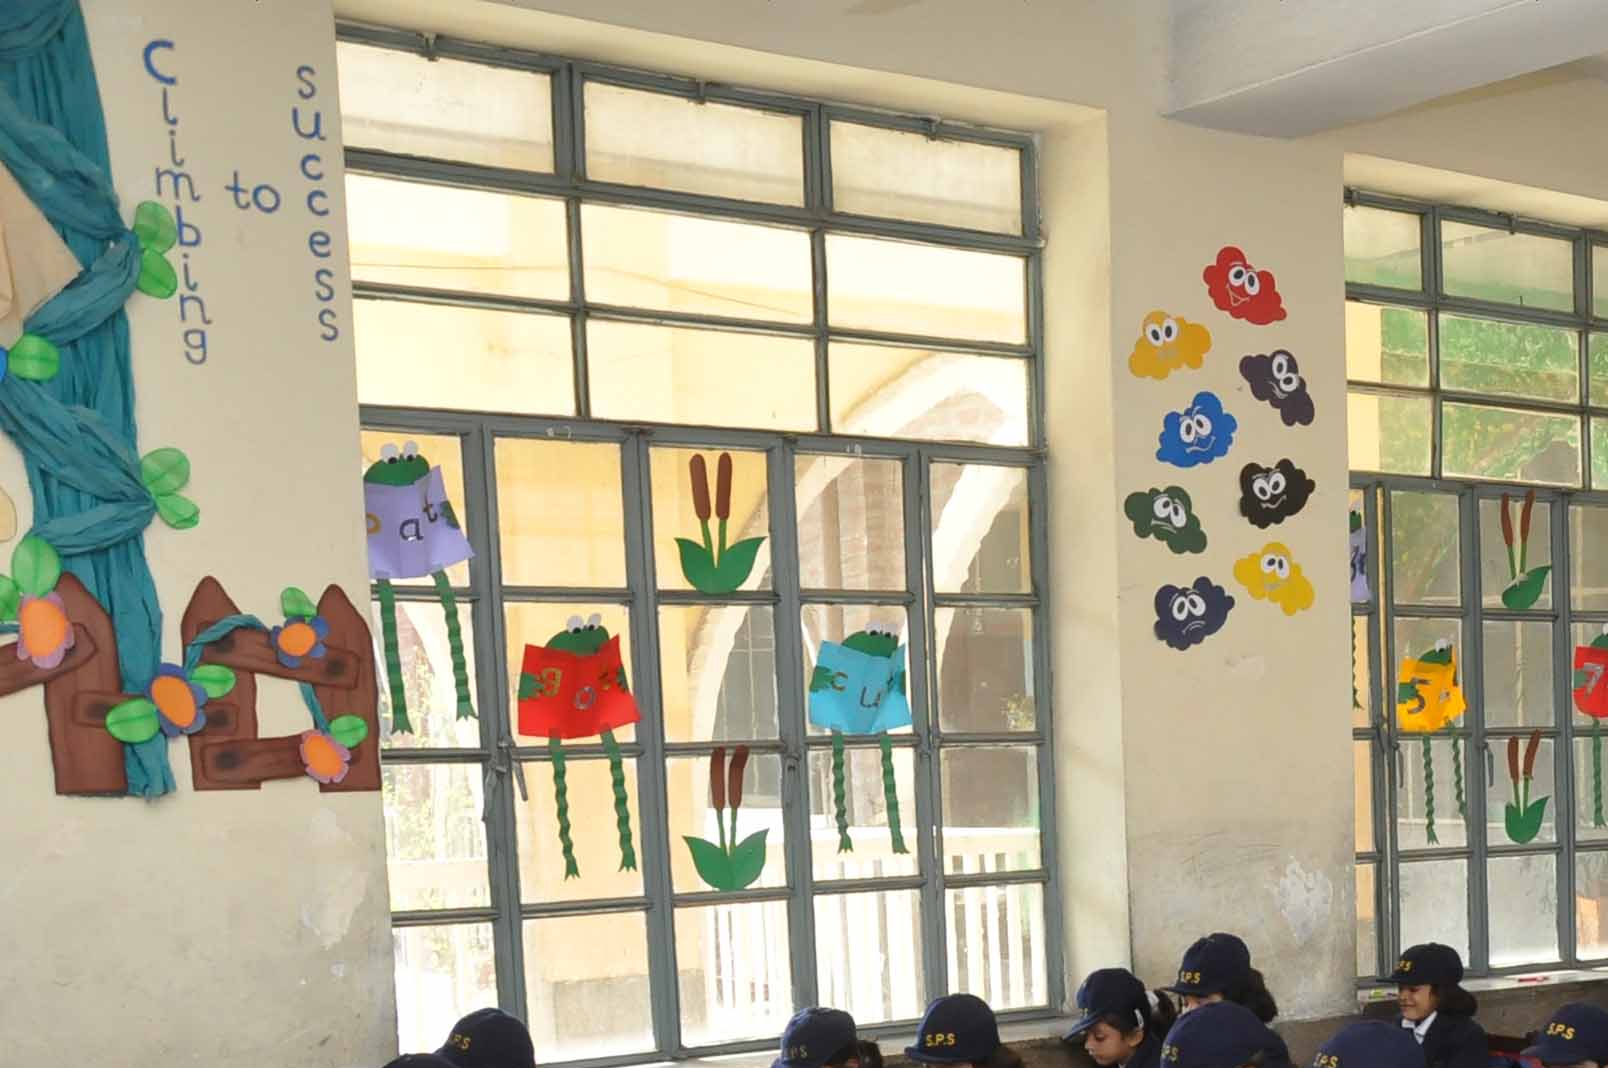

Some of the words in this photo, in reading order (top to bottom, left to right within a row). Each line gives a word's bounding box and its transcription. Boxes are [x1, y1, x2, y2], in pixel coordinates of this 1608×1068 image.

[142, 39, 212, 365] Climbing
[224, 170, 281, 214] to
[292, 64, 339, 342] success
[925, 1032, 957, 1048] S.P.S
